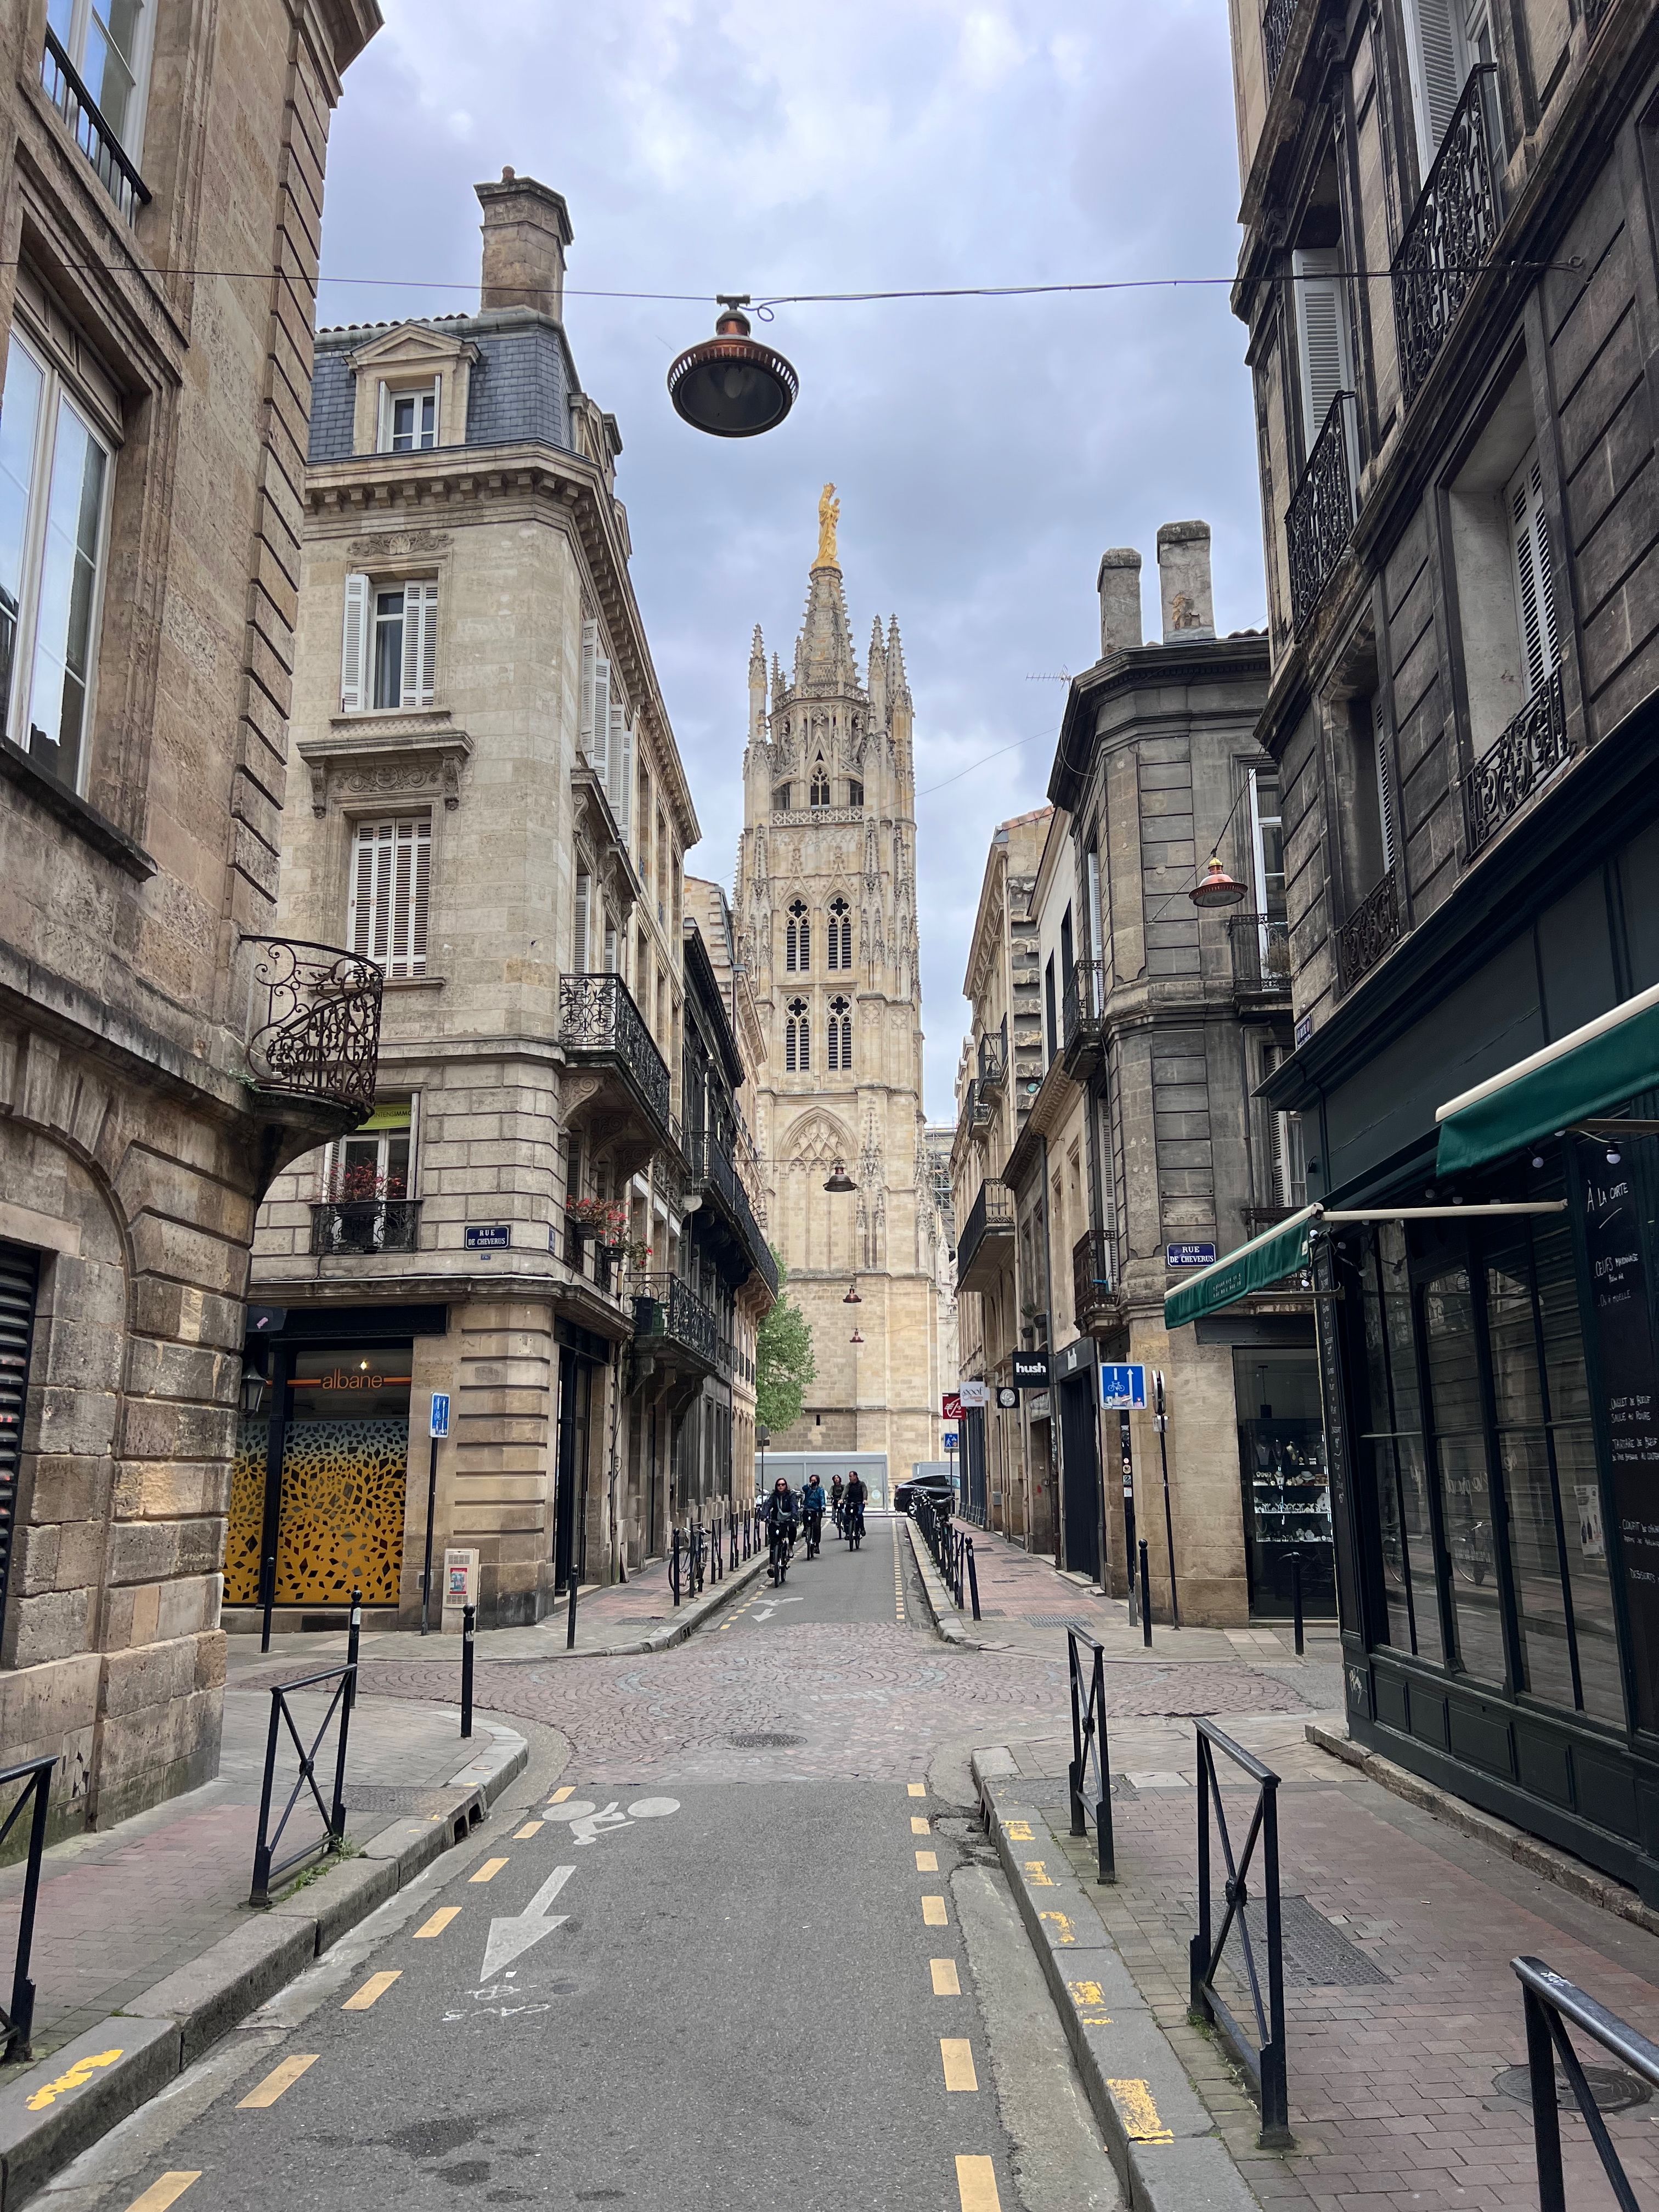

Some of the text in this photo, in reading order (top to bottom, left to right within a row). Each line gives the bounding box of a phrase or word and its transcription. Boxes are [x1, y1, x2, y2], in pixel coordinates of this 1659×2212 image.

[1598, 1187, 1607, 1206] LA
[1610, 1182, 1628, 1199] CARTE
[477, 1237, 506, 1245] CHEVERUS
[1015, 1362, 1046, 1373] hush
[322, 1368, 382, 1389] albane
